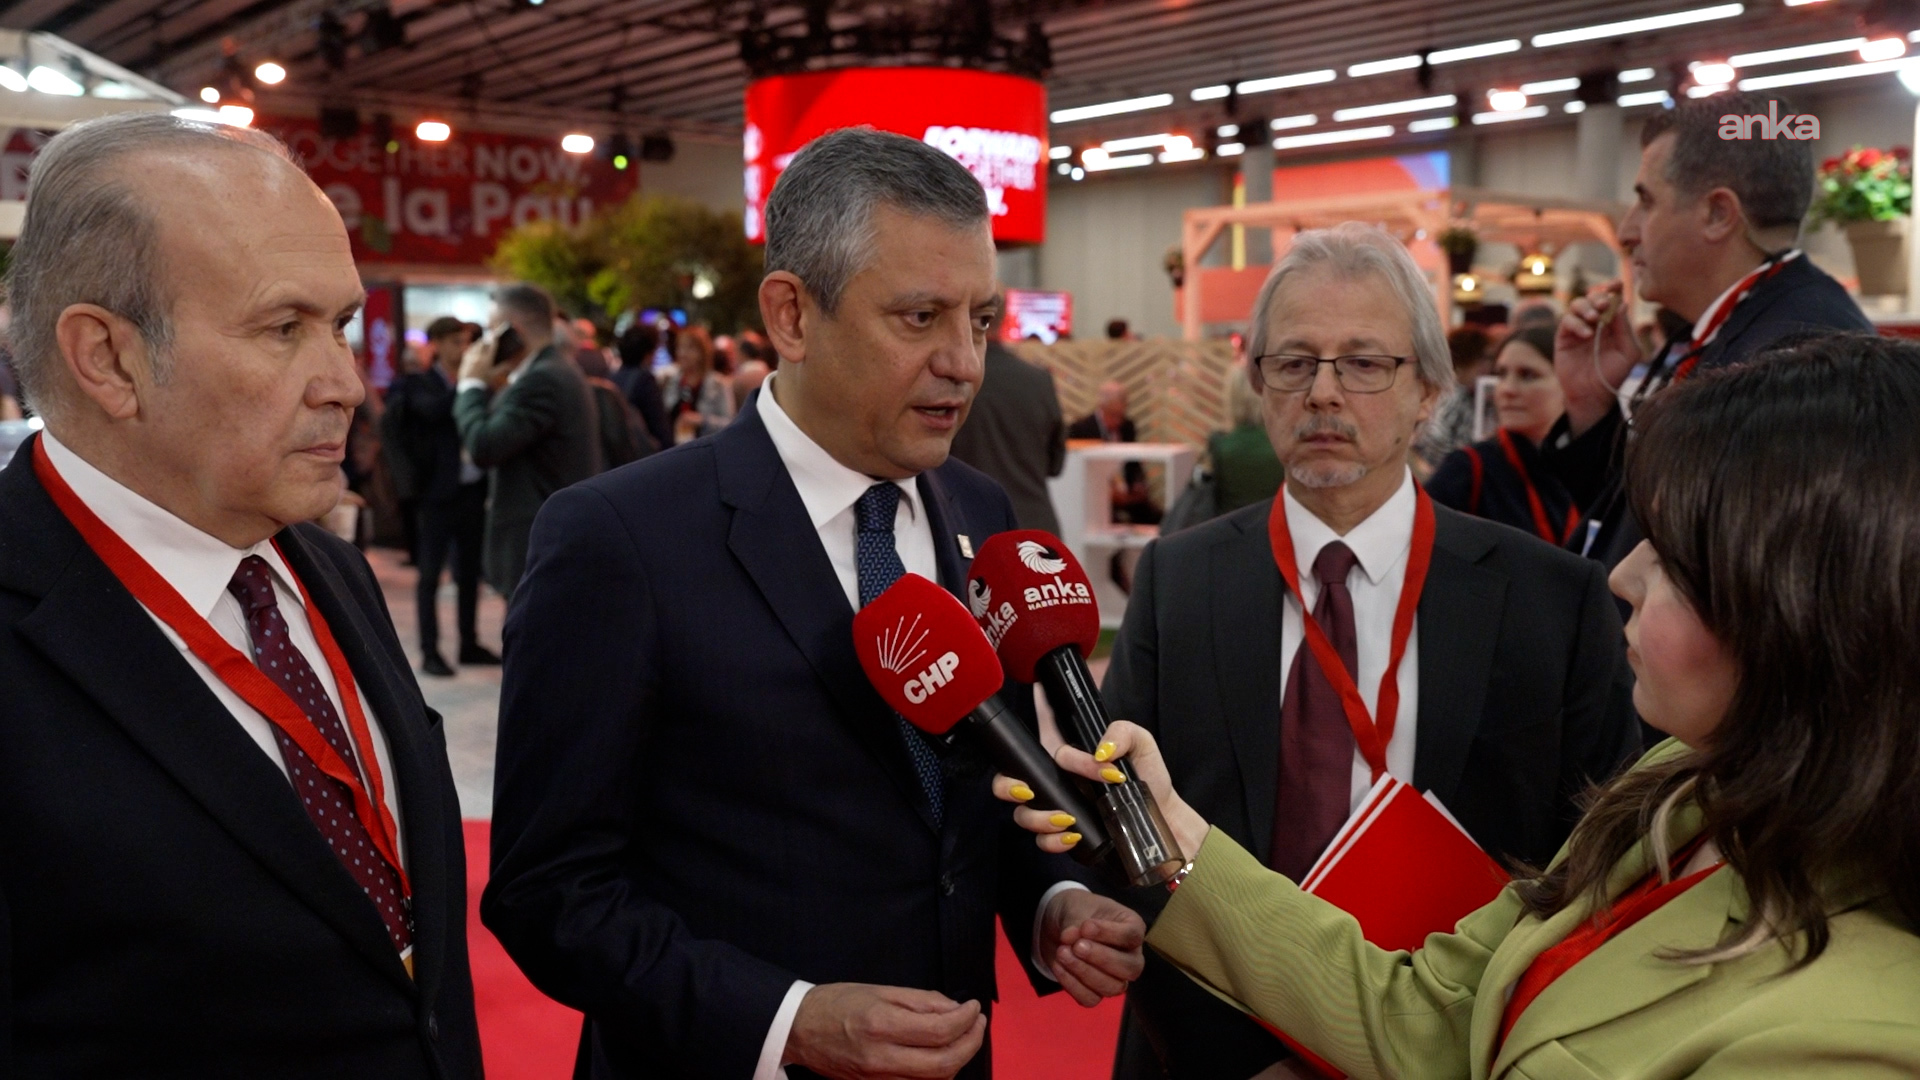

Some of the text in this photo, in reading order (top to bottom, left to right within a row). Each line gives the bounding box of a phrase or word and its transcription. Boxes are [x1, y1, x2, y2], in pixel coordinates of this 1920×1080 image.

[474, 142, 591, 186] NOW.
[382, 175, 450, 236] la
[1023, 575, 1090, 603] anka
[1027, 599, 1060, 611] HABER
[984, 601, 1016, 646] nka
[903, 651, 960, 704] CHP
